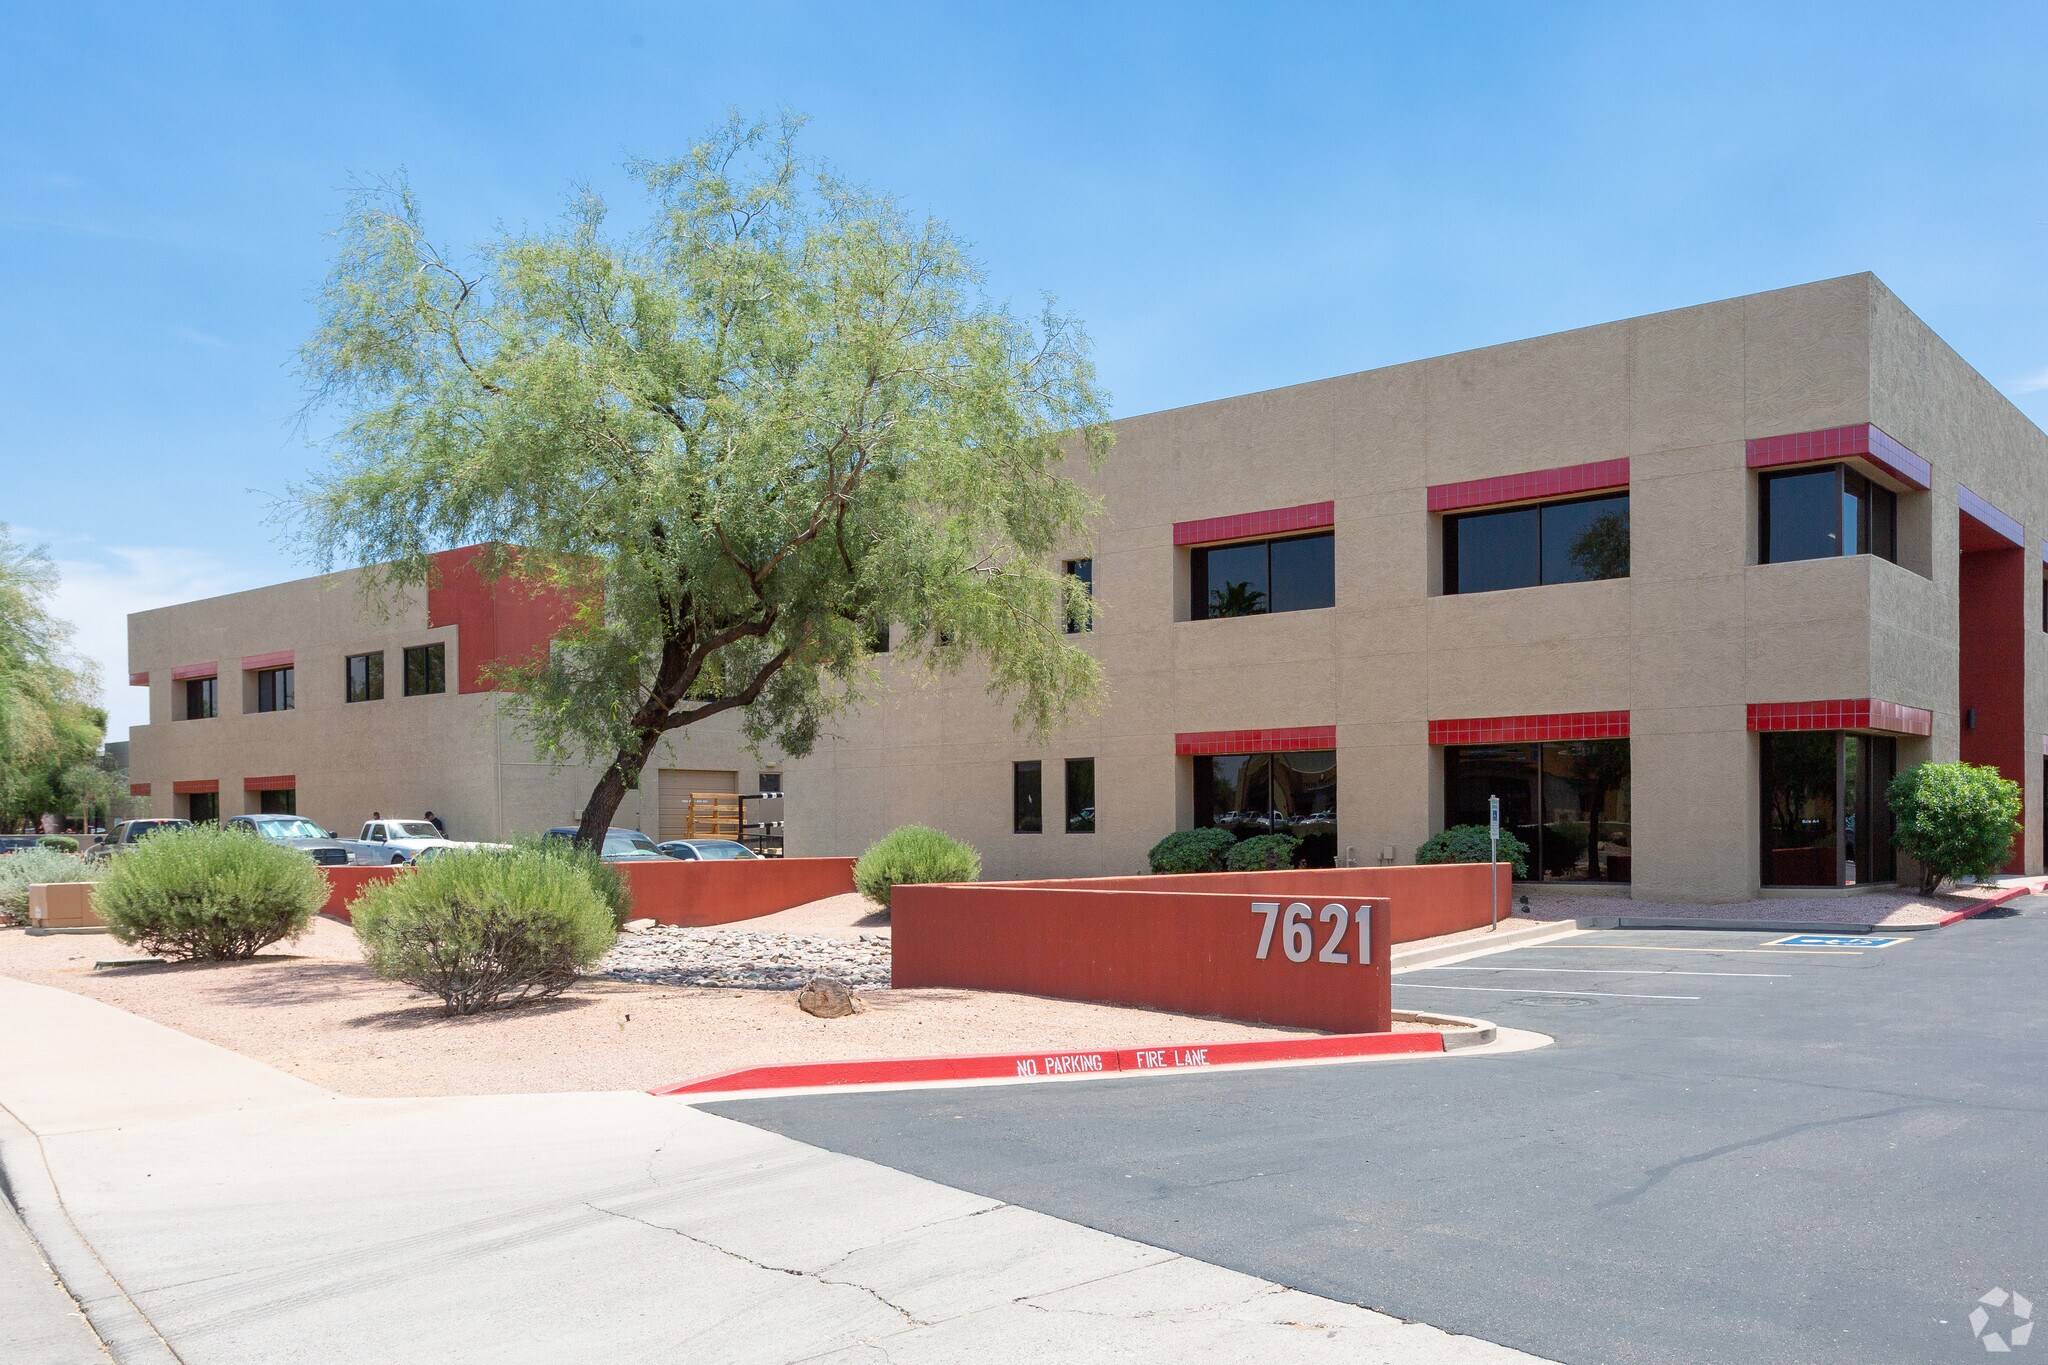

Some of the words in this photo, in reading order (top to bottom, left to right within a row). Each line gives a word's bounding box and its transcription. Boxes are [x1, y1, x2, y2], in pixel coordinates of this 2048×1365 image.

[1251, 902, 1372, 965] 7621
[1016, 1059, 1037, 1077] NO
[1045, 1055, 1103, 1075] PARKING
[1136, 1050, 1167, 1068] FIRE
[1175, 1049, 1210, 1066] LANE
